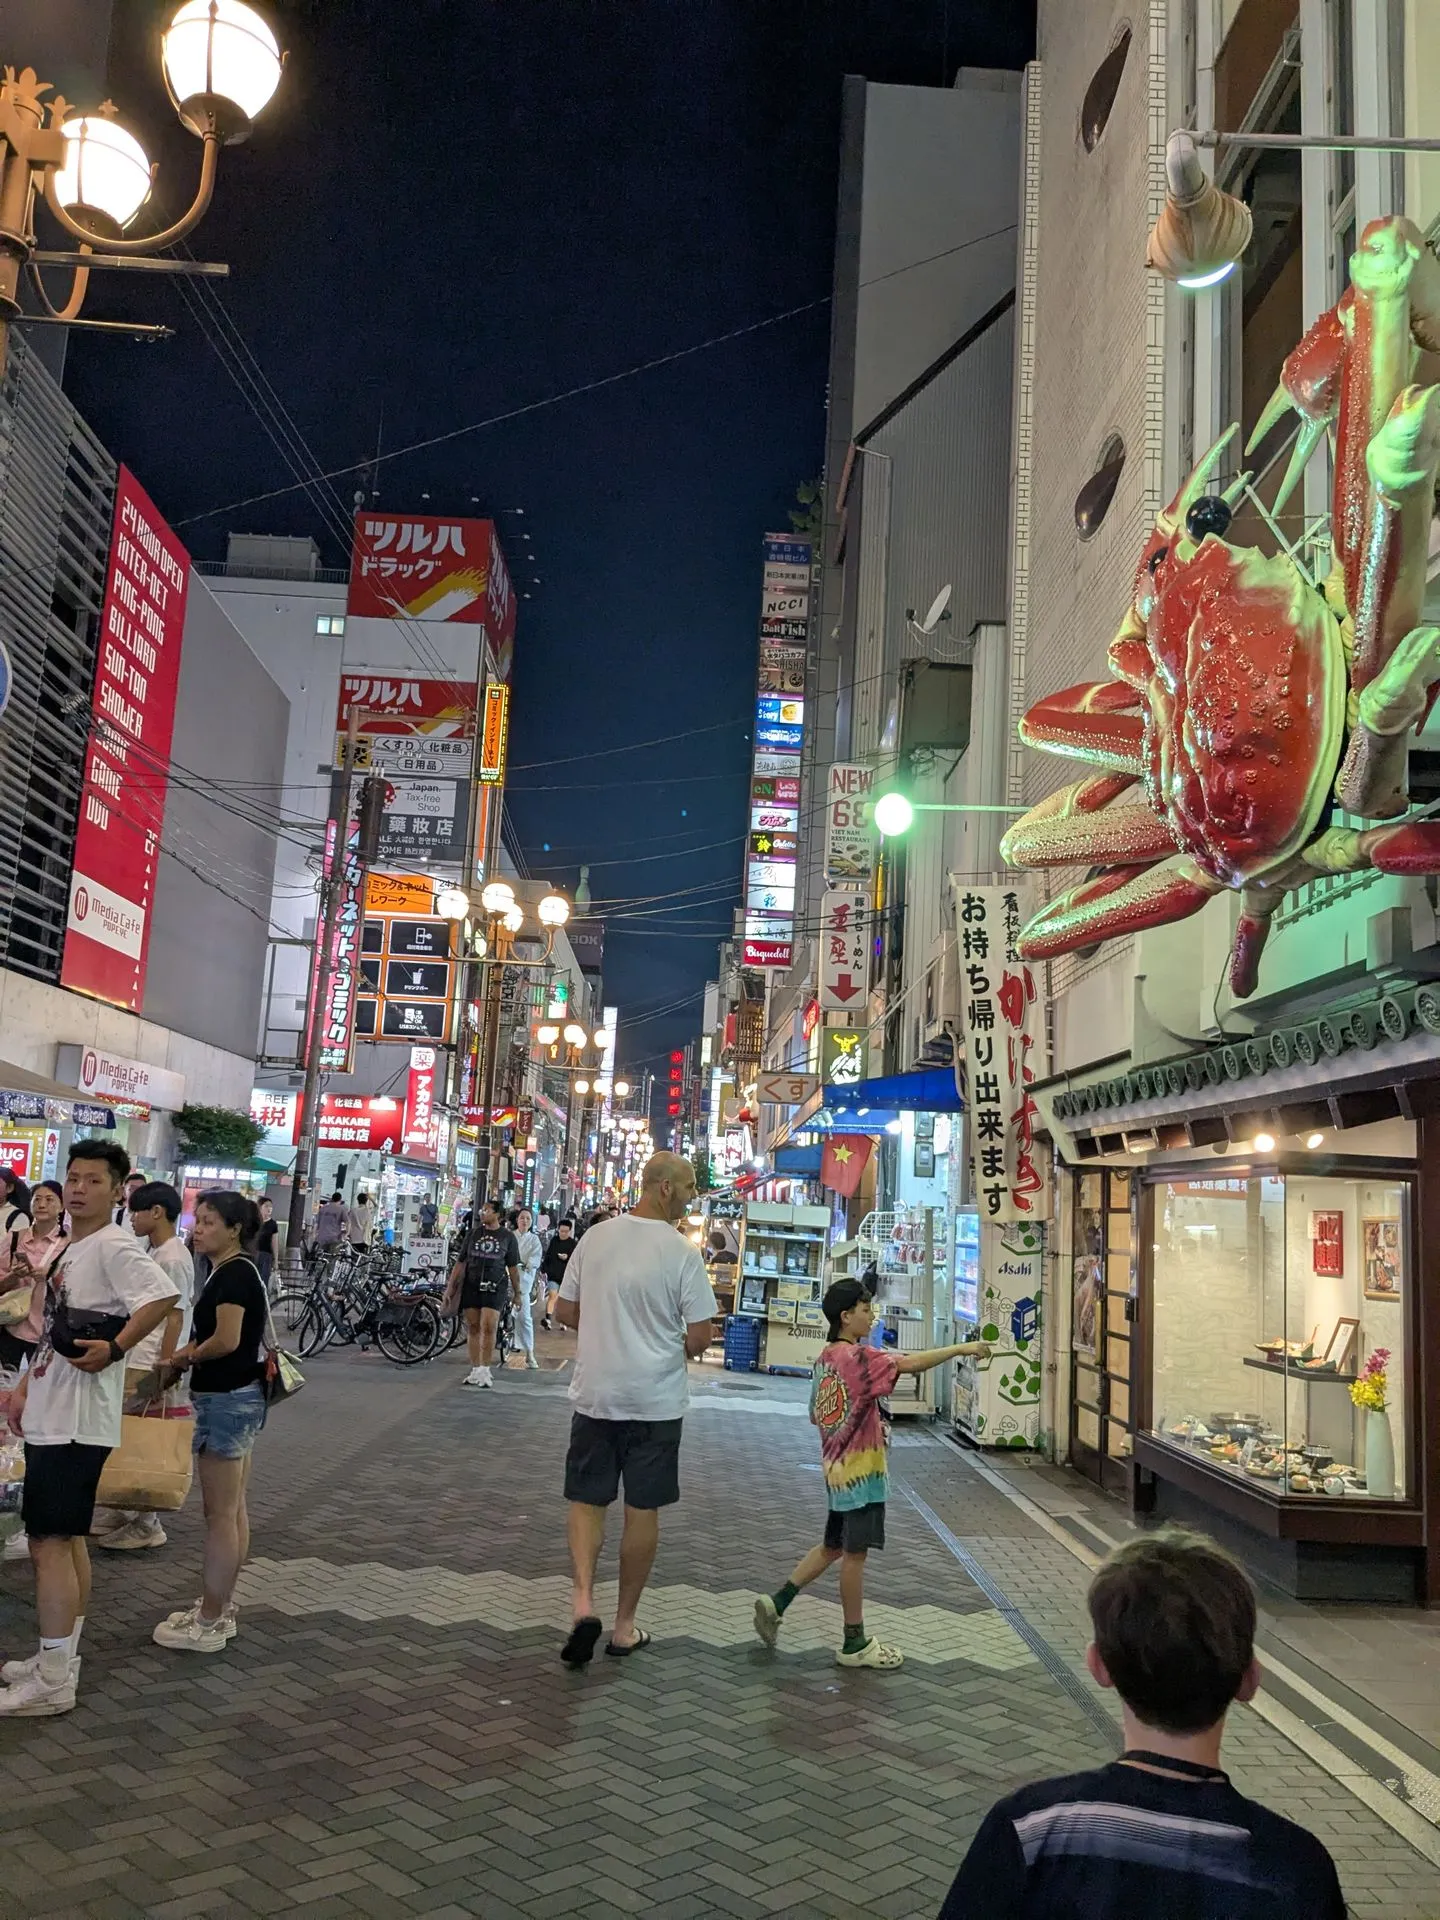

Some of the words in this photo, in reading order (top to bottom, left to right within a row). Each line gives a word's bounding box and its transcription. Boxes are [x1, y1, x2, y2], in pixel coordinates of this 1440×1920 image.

[123, 496, 138, 534] 24
[137, 516, 161, 566] HOUR
[160, 549, 182, 594] OPEN
[364, 521, 466, 557] ツルハ
[118, 534, 169, 611] INTER-NET
[361, 556, 442, 580] ドラッグ
[114, 567, 165, 646] PING-PONG
[767, 597, 803, 613] NCCI
[109, 604, 156, 674] BILLIARD
[105, 642, 147, 704] SUN-TAN
[344, 679, 422, 706] ツルハ
[100, 680, 144, 740] SHOWER
[383, 740, 415, 751] くすり
[429, 742, 463, 754] 化粧品
[90, 754, 123, 801] GAME
[404, 759, 438, 771] 日用品
[832, 769, 874, 795] NEW
[405, 793, 441, 804] Tax-free
[417, 803, 441, 813] Shop
[92, 897, 118, 925] Media
[119, 912, 141, 935] Cafe
[103, 919, 128, 940] POPEYE
[745, 945, 790, 962] Bisquedoll
[961, 892, 1008, 1216] お持ち帰り出来ます
[100, 1060, 127, 1080] Media
[128, 1067, 149, 1086] Cafe
[111, 1080, 137, 1094] POPEYE
[764, 1078, 821, 1101] くす
[413, 1075, 432, 1130] アカカベ
[319, 1116, 371, 1127] AKAKABE
[998, 1261, 1033, 1276] Asahi
